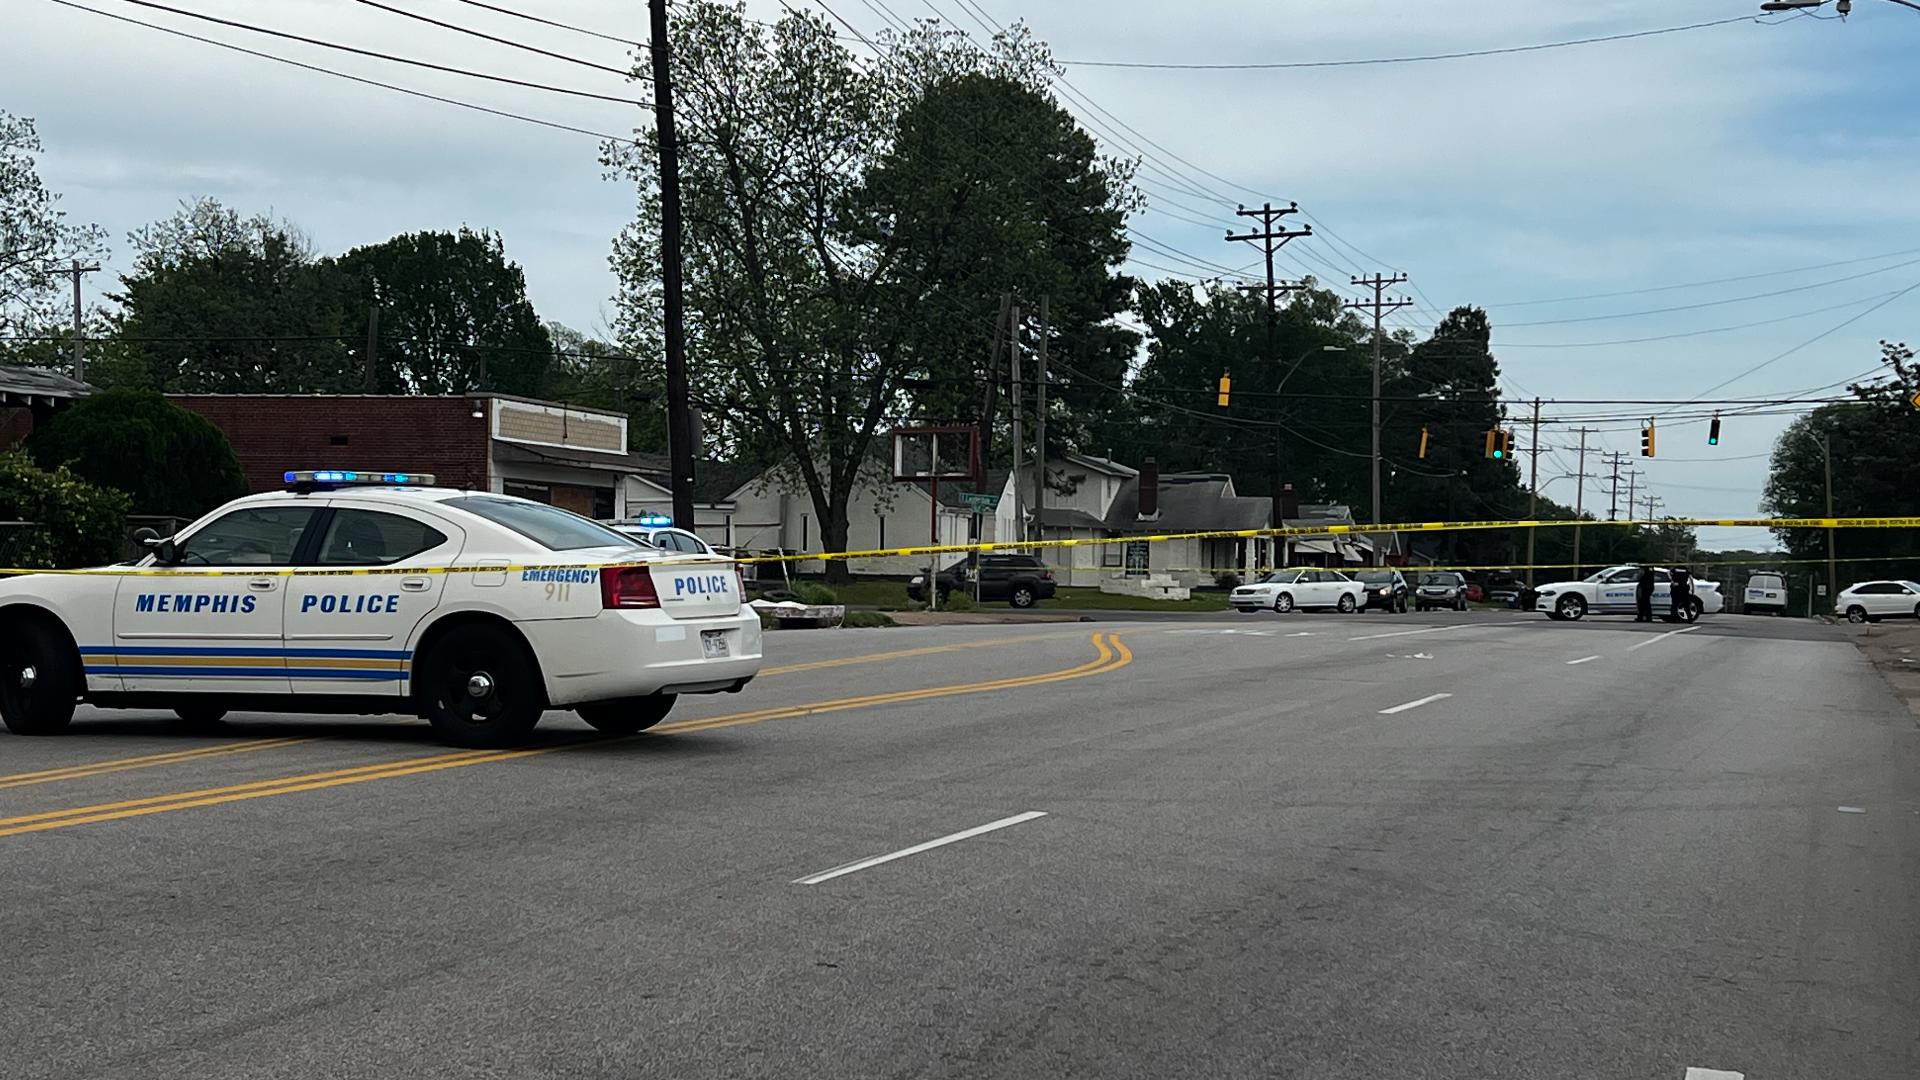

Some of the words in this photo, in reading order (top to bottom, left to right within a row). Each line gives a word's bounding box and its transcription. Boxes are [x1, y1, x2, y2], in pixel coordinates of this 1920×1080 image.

[522, 568, 598, 584] EMERGENCY
[545, 584, 570, 601] 911
[674, 576, 728, 596] POLICE
[135, 594, 256, 613] MEMPHIS
[301, 594, 399, 613] POLICE
